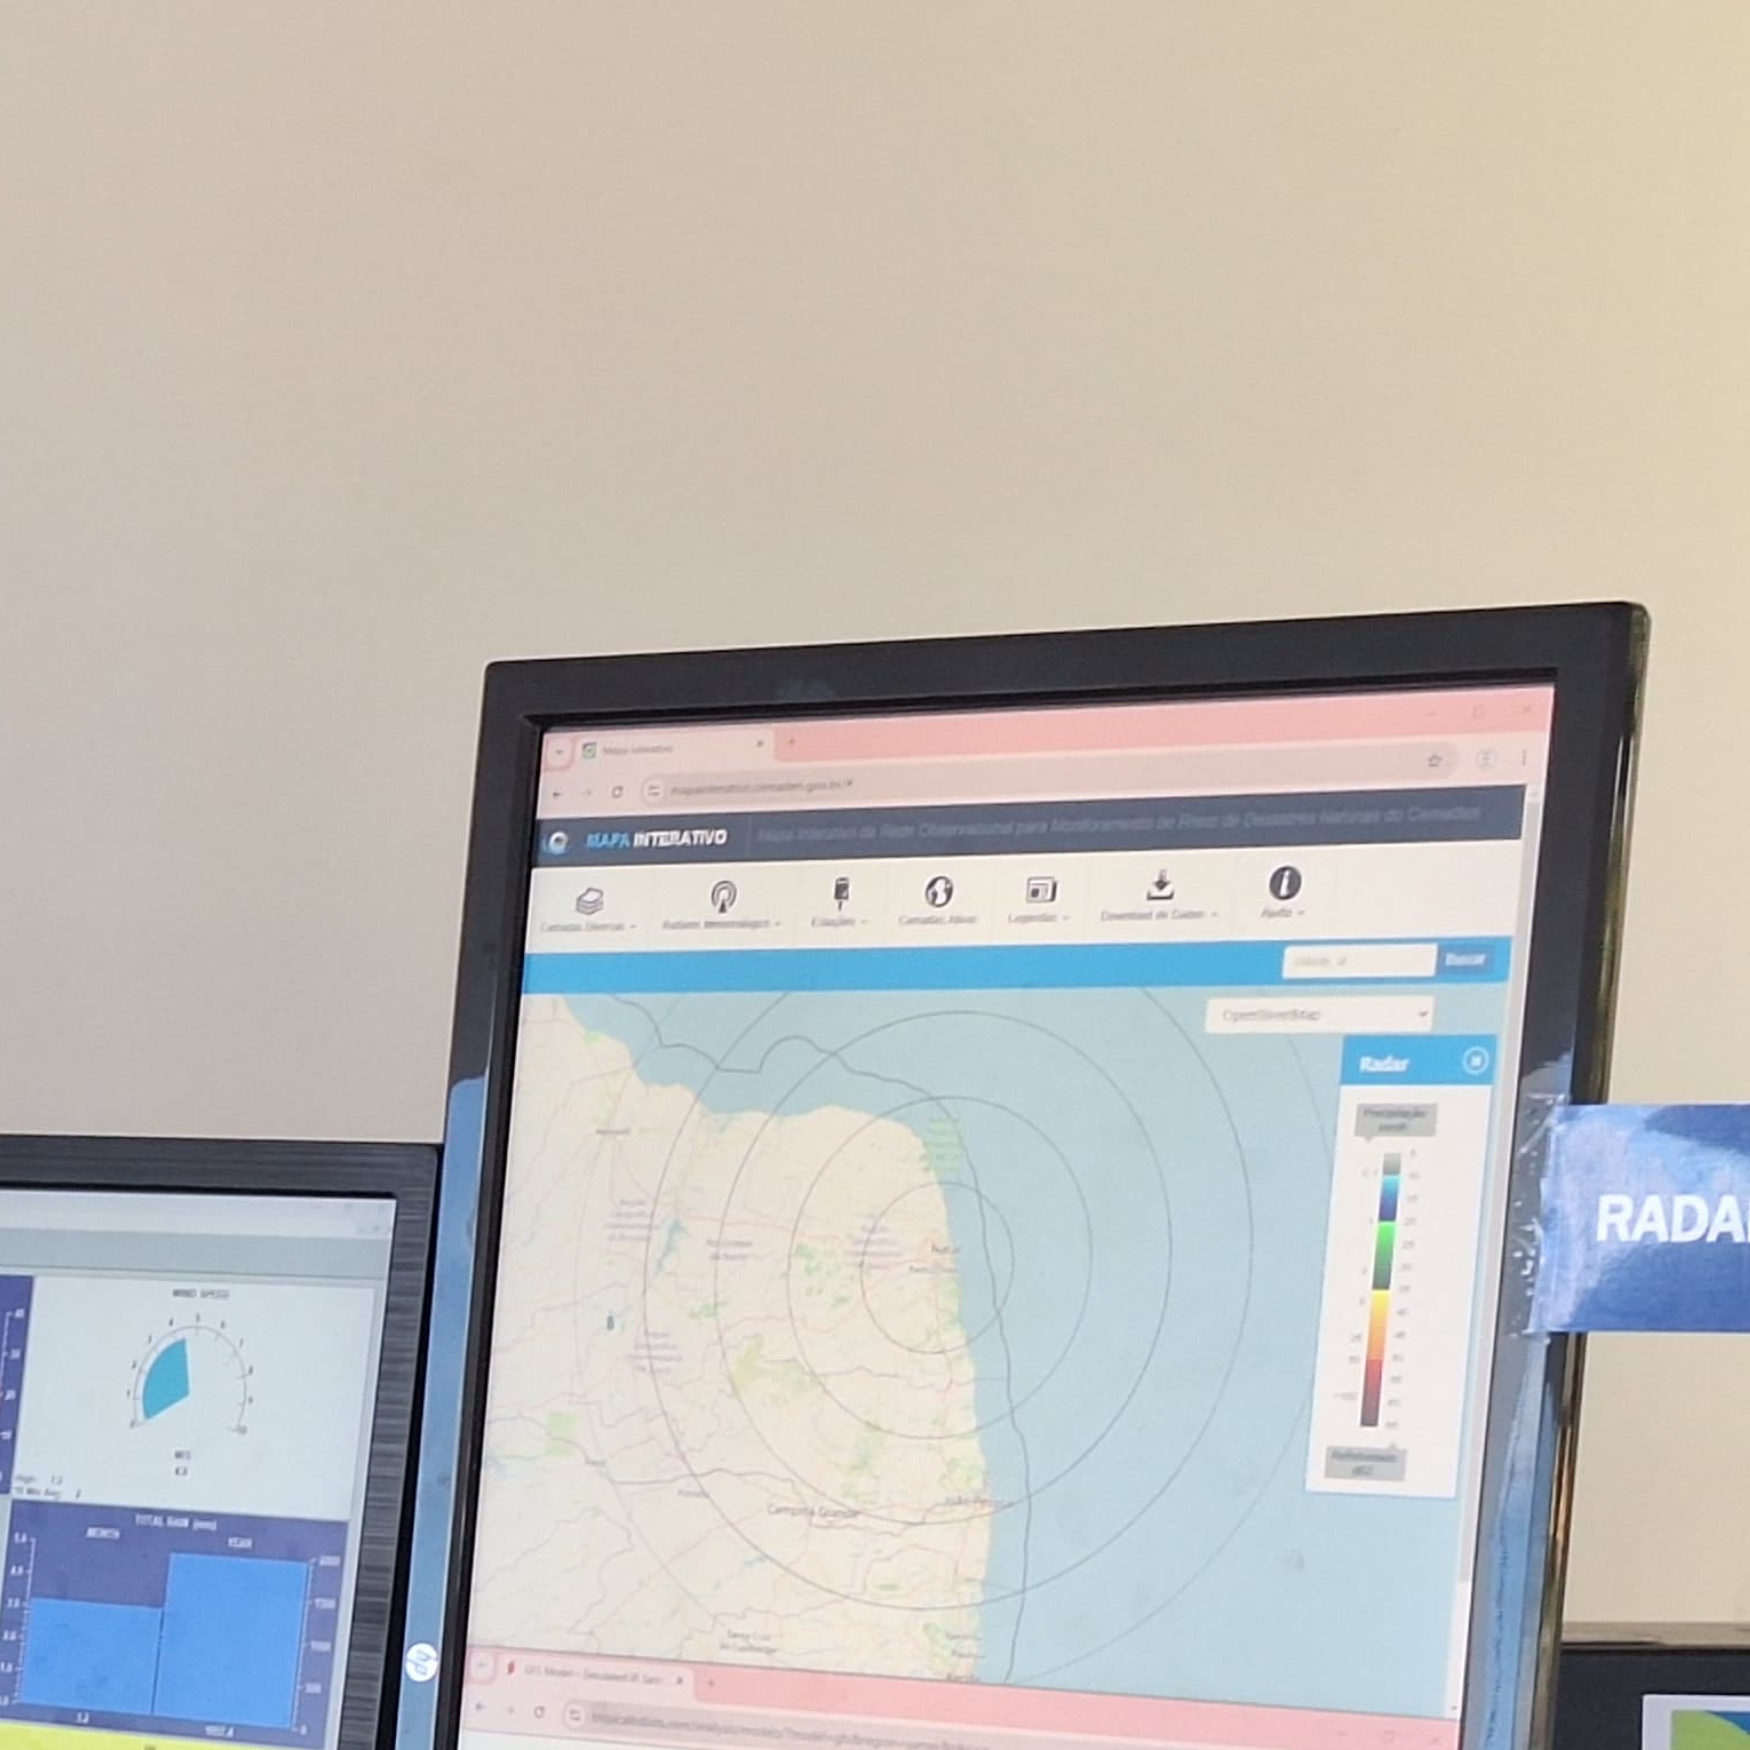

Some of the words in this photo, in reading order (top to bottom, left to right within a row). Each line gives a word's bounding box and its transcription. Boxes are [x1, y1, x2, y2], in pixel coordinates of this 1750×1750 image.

[586, 832, 631, 848] MAPA
[633, 829, 728, 848] INTERATIVO
[1359, 1055, 1410, 1073] Radar
[1596, 1194, 1750, 1243] RADA
